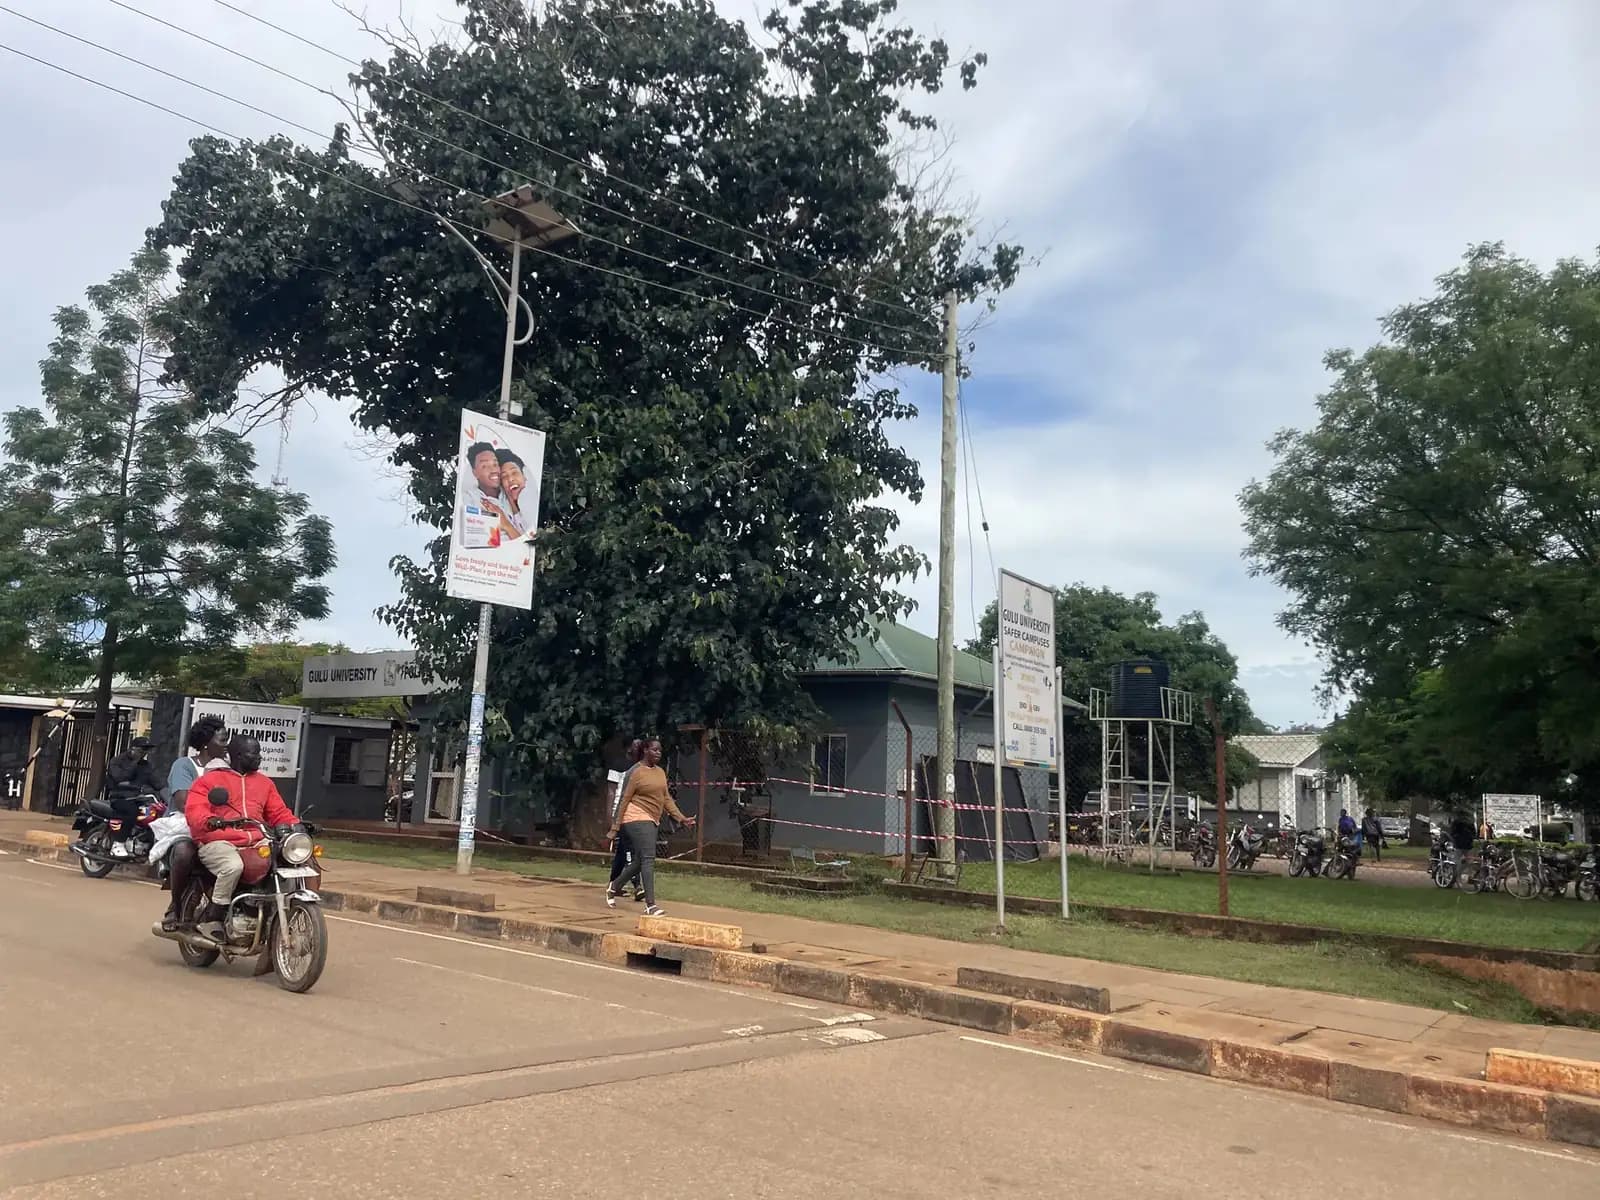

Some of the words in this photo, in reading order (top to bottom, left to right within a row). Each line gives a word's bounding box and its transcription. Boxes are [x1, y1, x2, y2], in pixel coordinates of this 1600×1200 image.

[1003, 608, 1019, 625] GULU
[1019, 614, 1051, 635] UNIVERSITY
[1003, 625, 1021, 639] SAFER
[1021, 631, 1050, 649] CAMPUSES
[1009, 640, 1046, 659] CAMPAIGN
[308, 669, 329, 683] GULU
[330, 667, 378, 682] UNIVERSITY
[242, 715, 297, 728] UNIVERSITY
